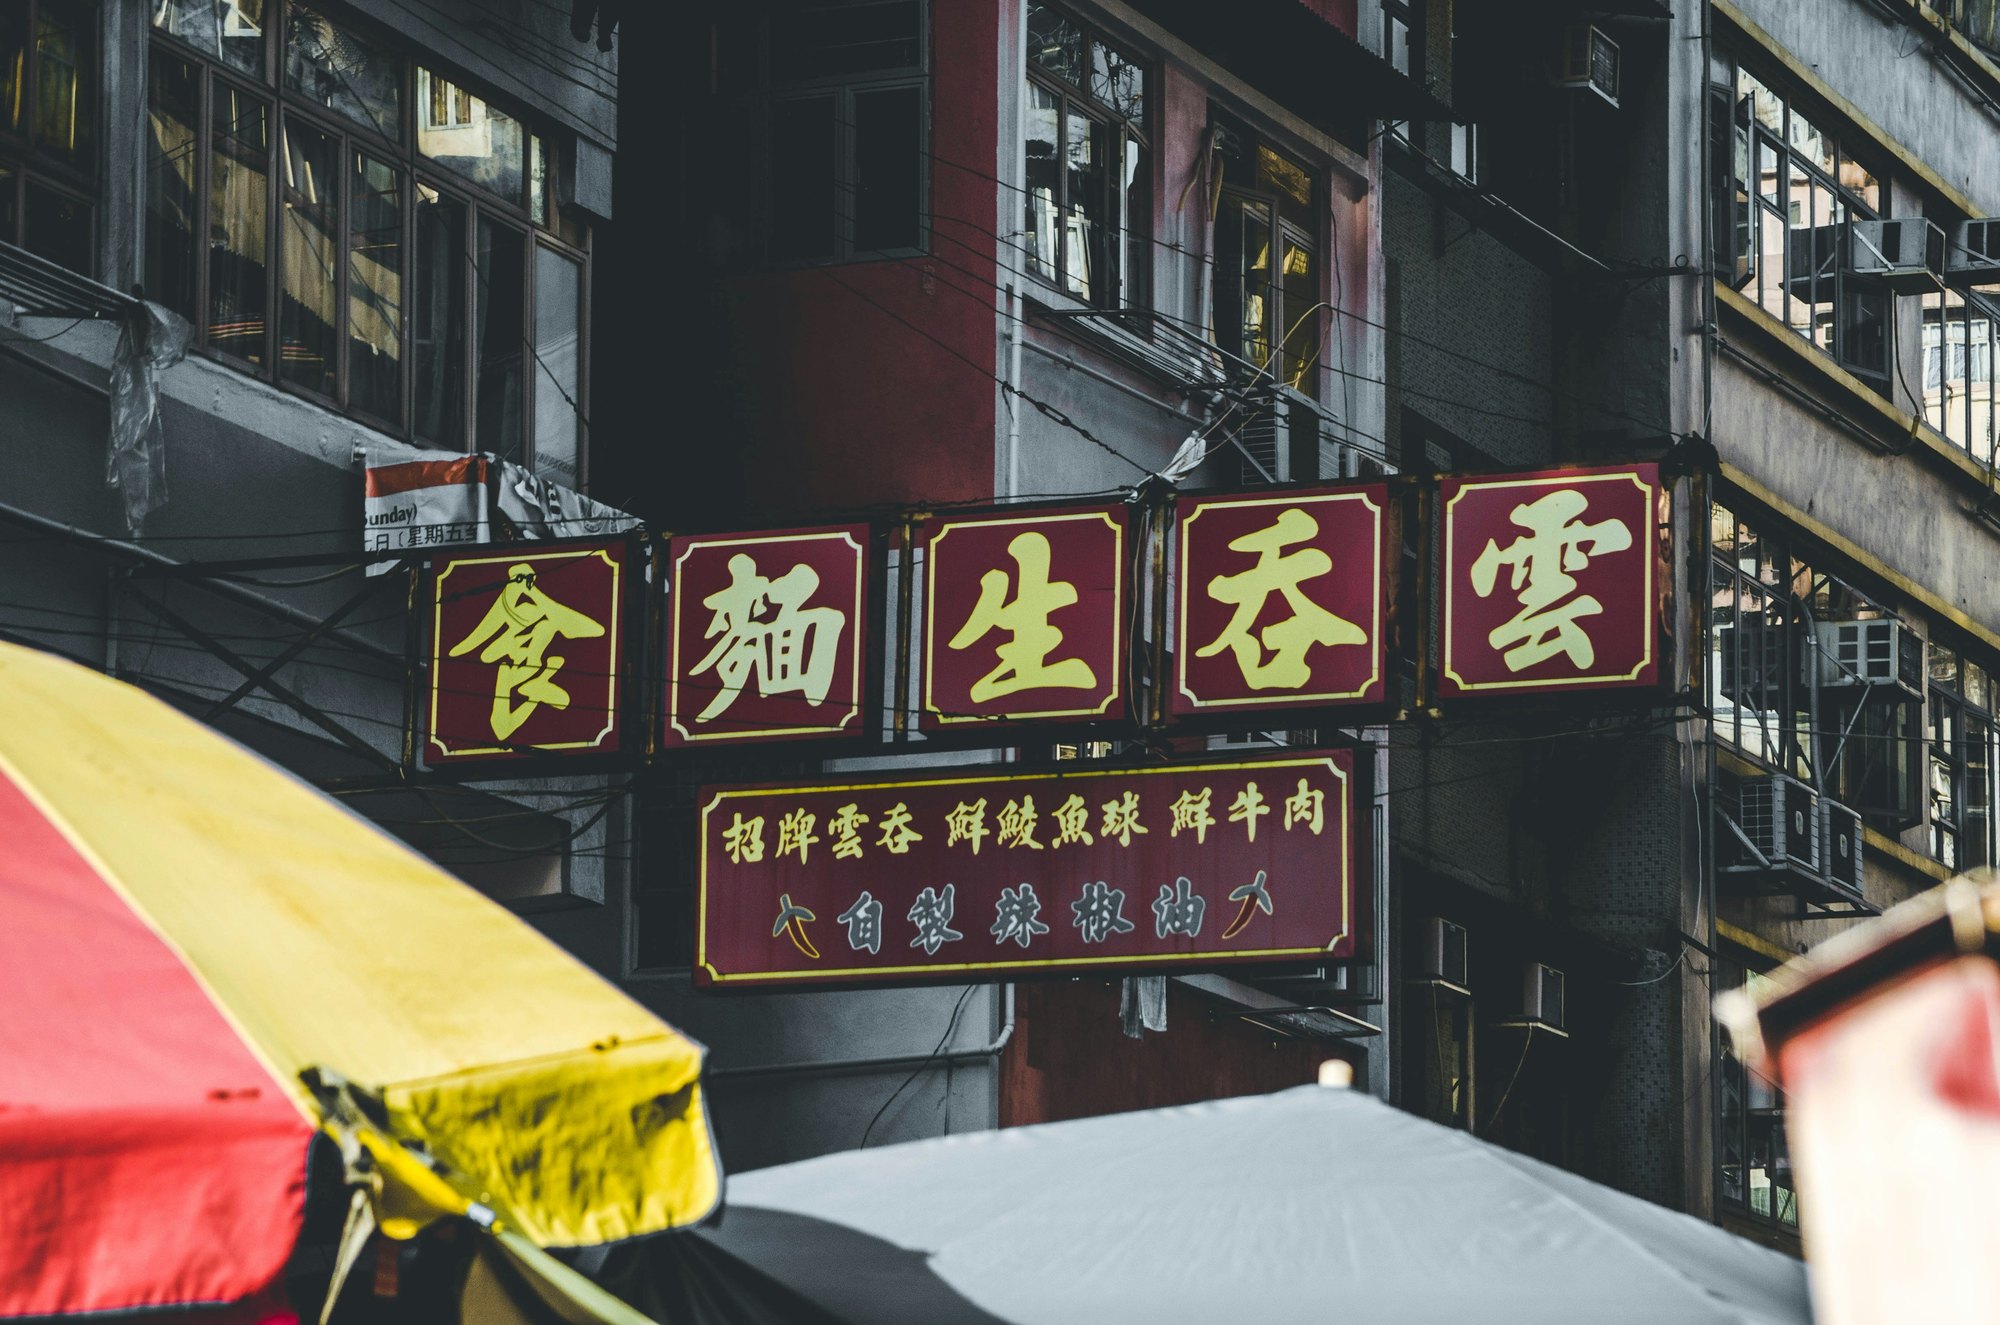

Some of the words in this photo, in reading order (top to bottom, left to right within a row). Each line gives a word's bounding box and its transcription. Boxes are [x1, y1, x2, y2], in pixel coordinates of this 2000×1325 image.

[365, 503, 417, 526] unday)
[1169, 778, 1324, 844] 鮮牛肉
[837, 876, 1206, 955] 自製辣椒油
